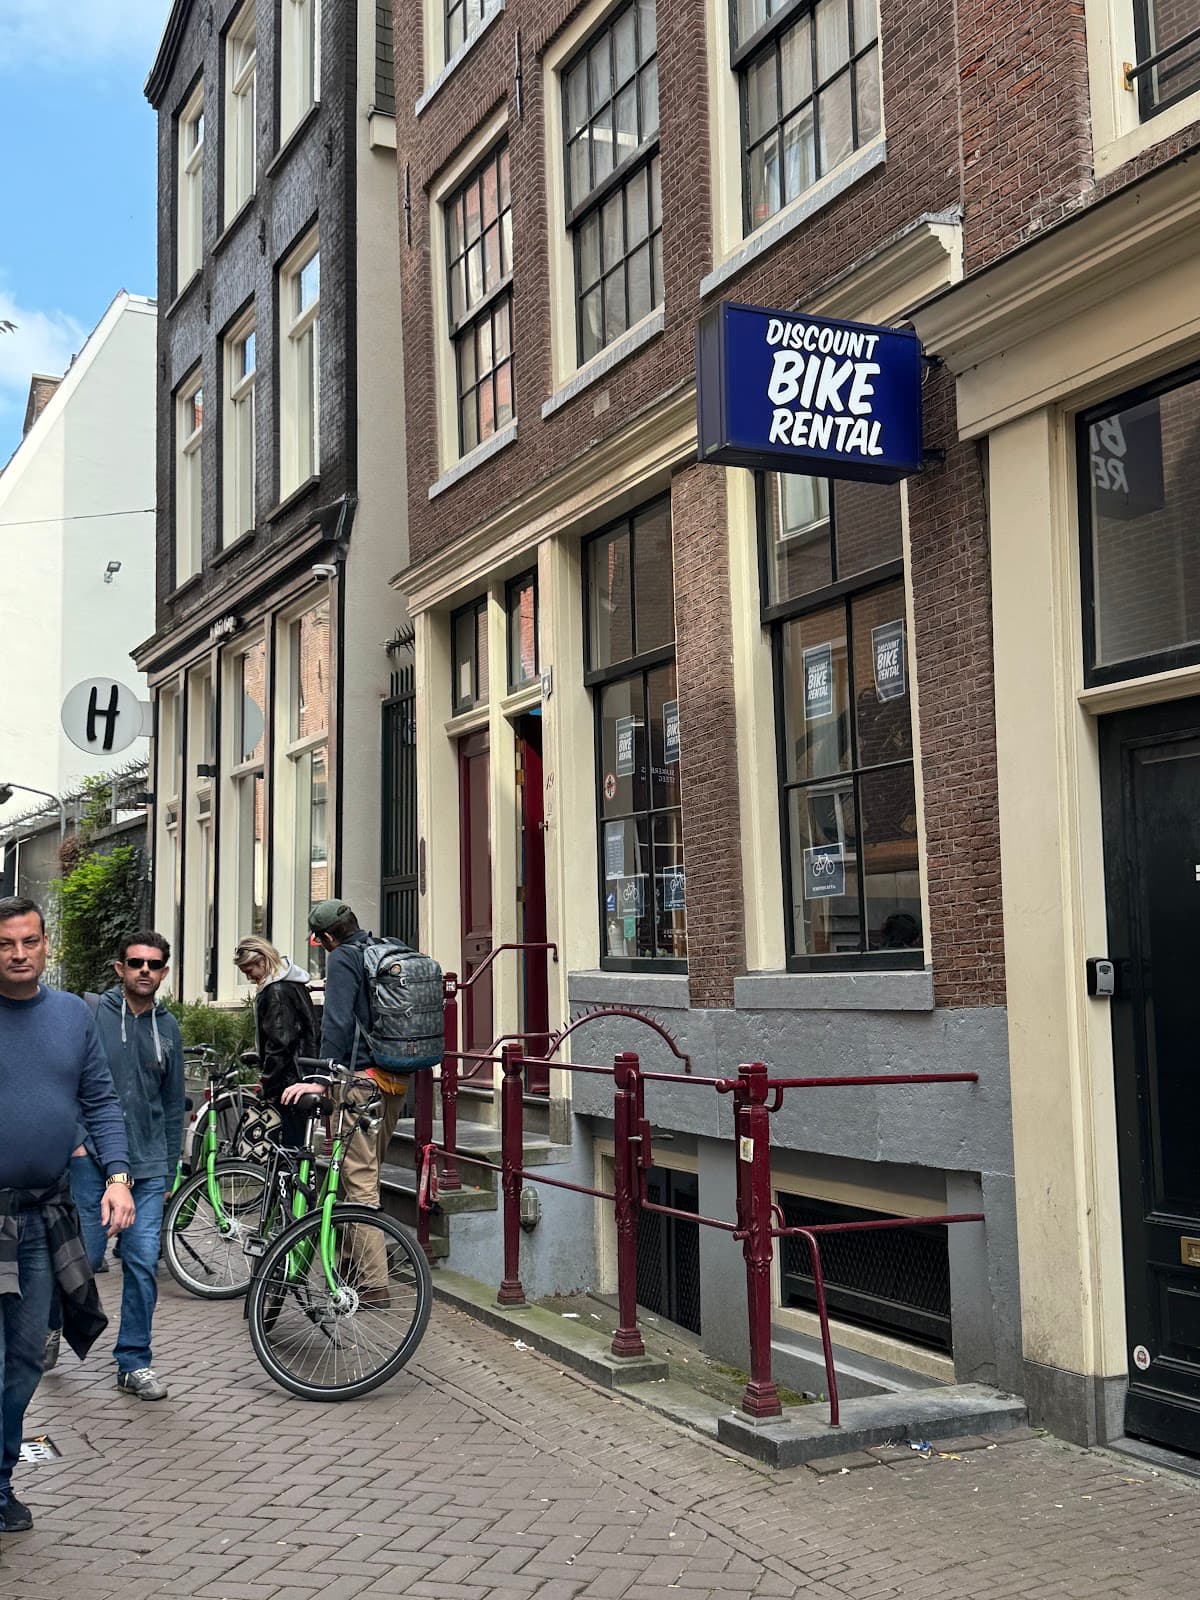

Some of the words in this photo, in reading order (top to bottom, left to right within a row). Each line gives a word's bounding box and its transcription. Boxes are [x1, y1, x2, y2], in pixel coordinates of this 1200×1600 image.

[765, 319, 880, 360] DISCOUNT
[767, 350, 881, 415] BIKE
[769, 408, 884, 456] RENTAL
[878, 648, 898, 670] BIKE
[808, 670, 827, 689] BIKE
[878, 665, 899, 681] RENTAL
[808, 686, 828, 700] RENTAL
[86, 684, 120, 750] H
[619, 738, 632, 752] BIKE
